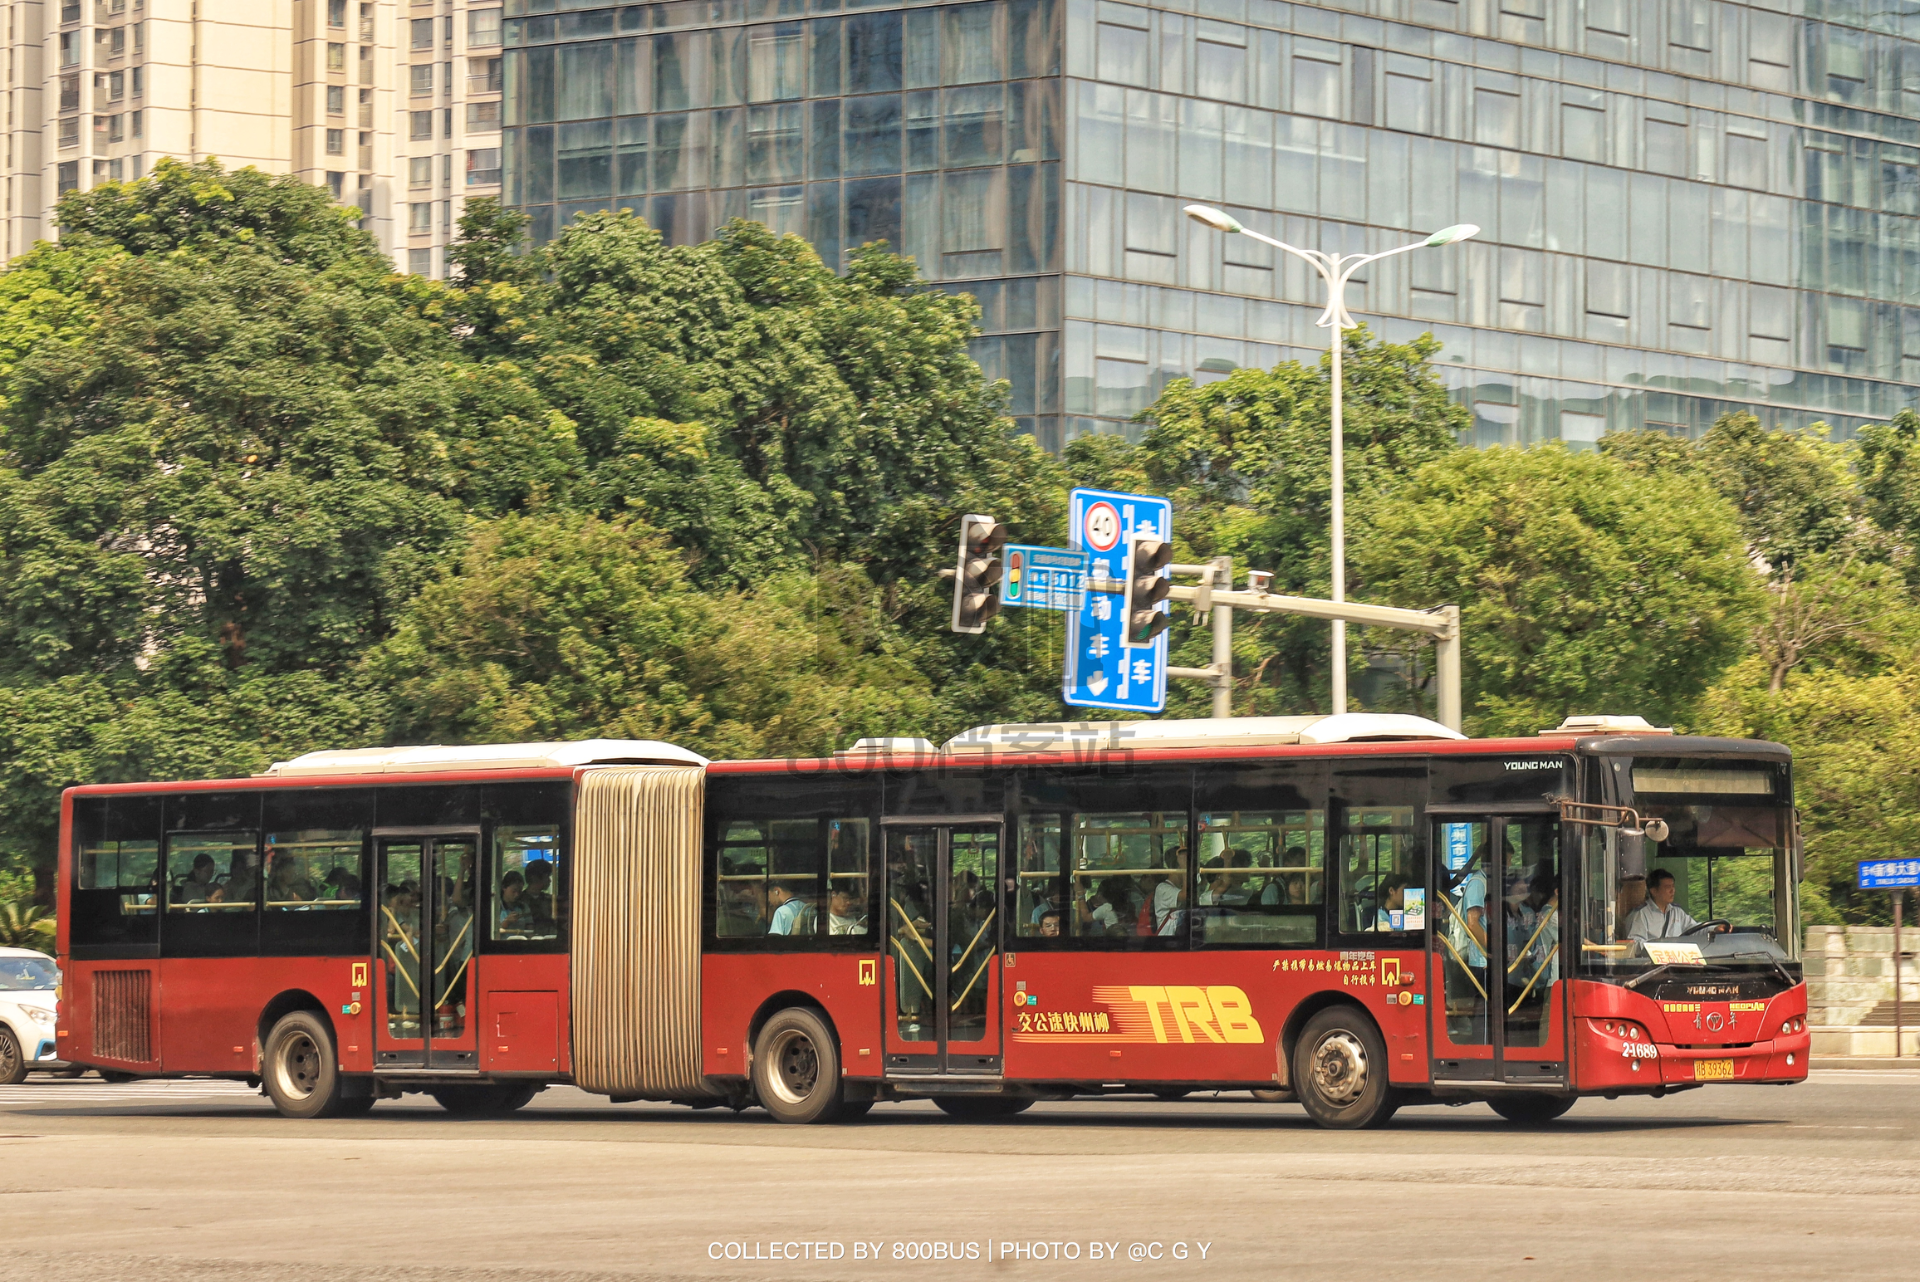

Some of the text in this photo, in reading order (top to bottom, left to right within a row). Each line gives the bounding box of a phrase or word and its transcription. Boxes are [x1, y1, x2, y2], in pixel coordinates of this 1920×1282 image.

[1093, 515, 1113, 537] 40
[1504, 760, 1563, 770] YOUNG MAN
[1651, 950, 1704, 965] 定制公交
[1342, 973, 1376, 987] 自行投币
[1128, 985, 1265, 1044] TRB
